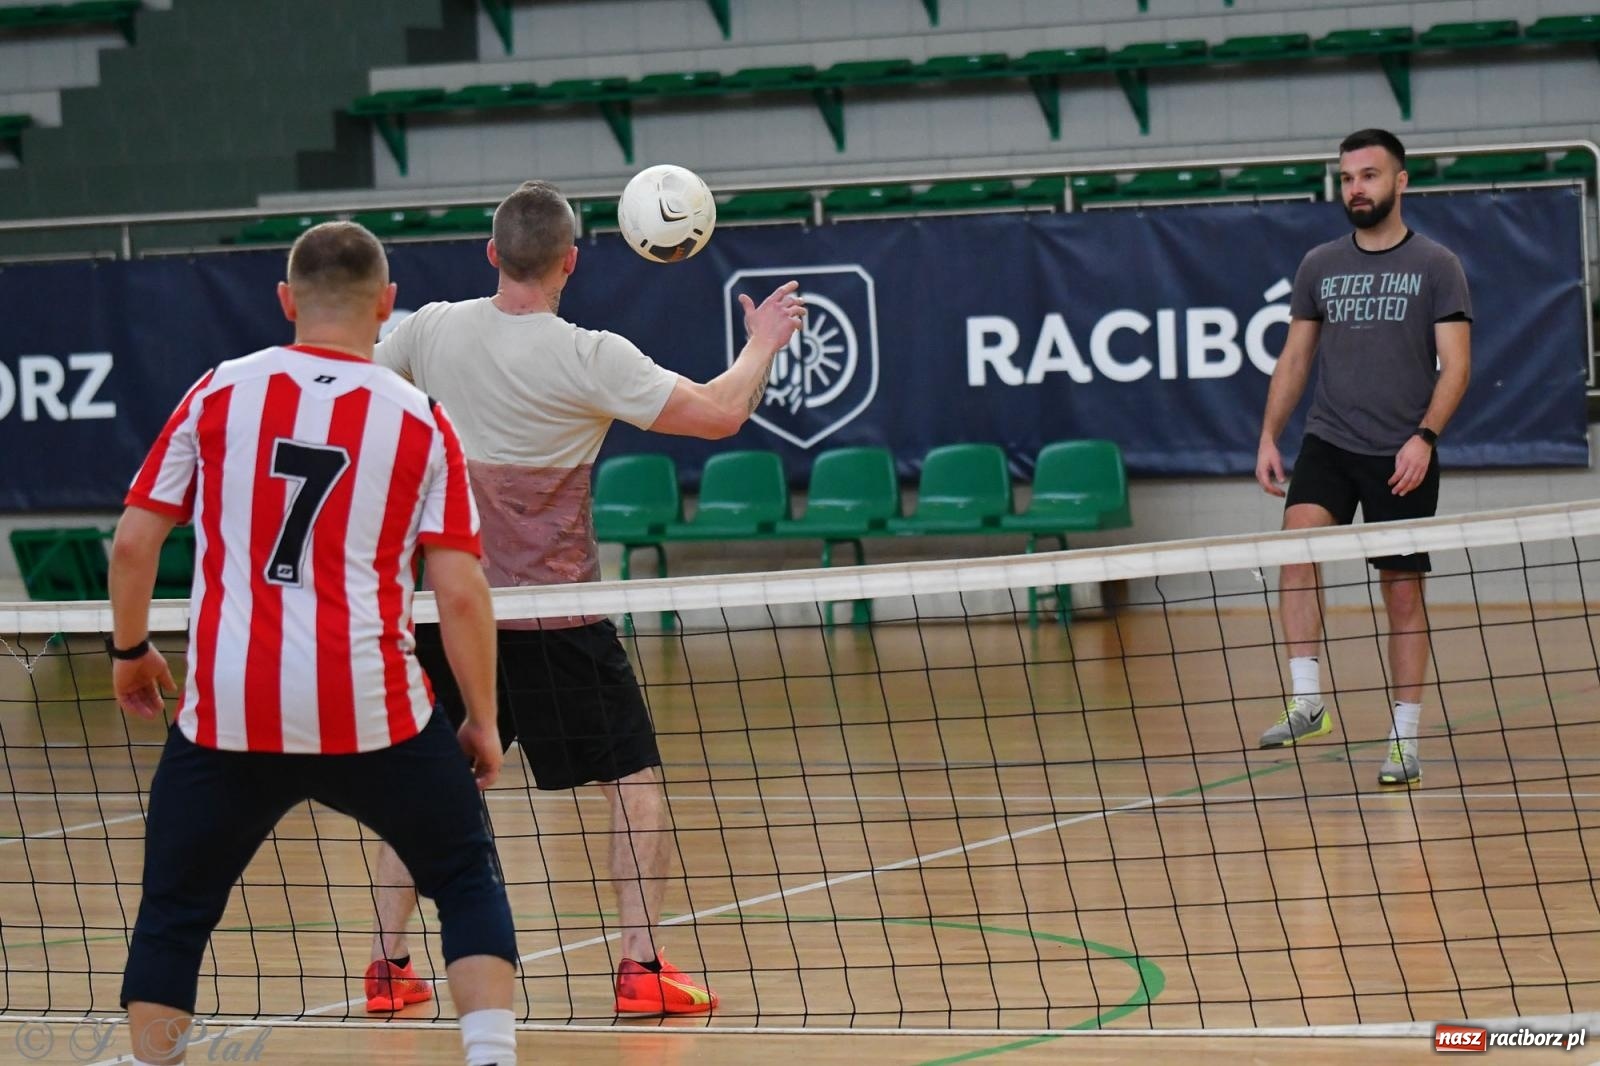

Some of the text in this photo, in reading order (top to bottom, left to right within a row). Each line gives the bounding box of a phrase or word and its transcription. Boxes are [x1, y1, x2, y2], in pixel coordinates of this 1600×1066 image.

[1320, 272, 1422, 299] BETTER THAN
[1326, 296, 1408, 324] EXPECTED
[966, 278, 1293, 387] RACIBÓ
[264, 436, 351, 588] 7
